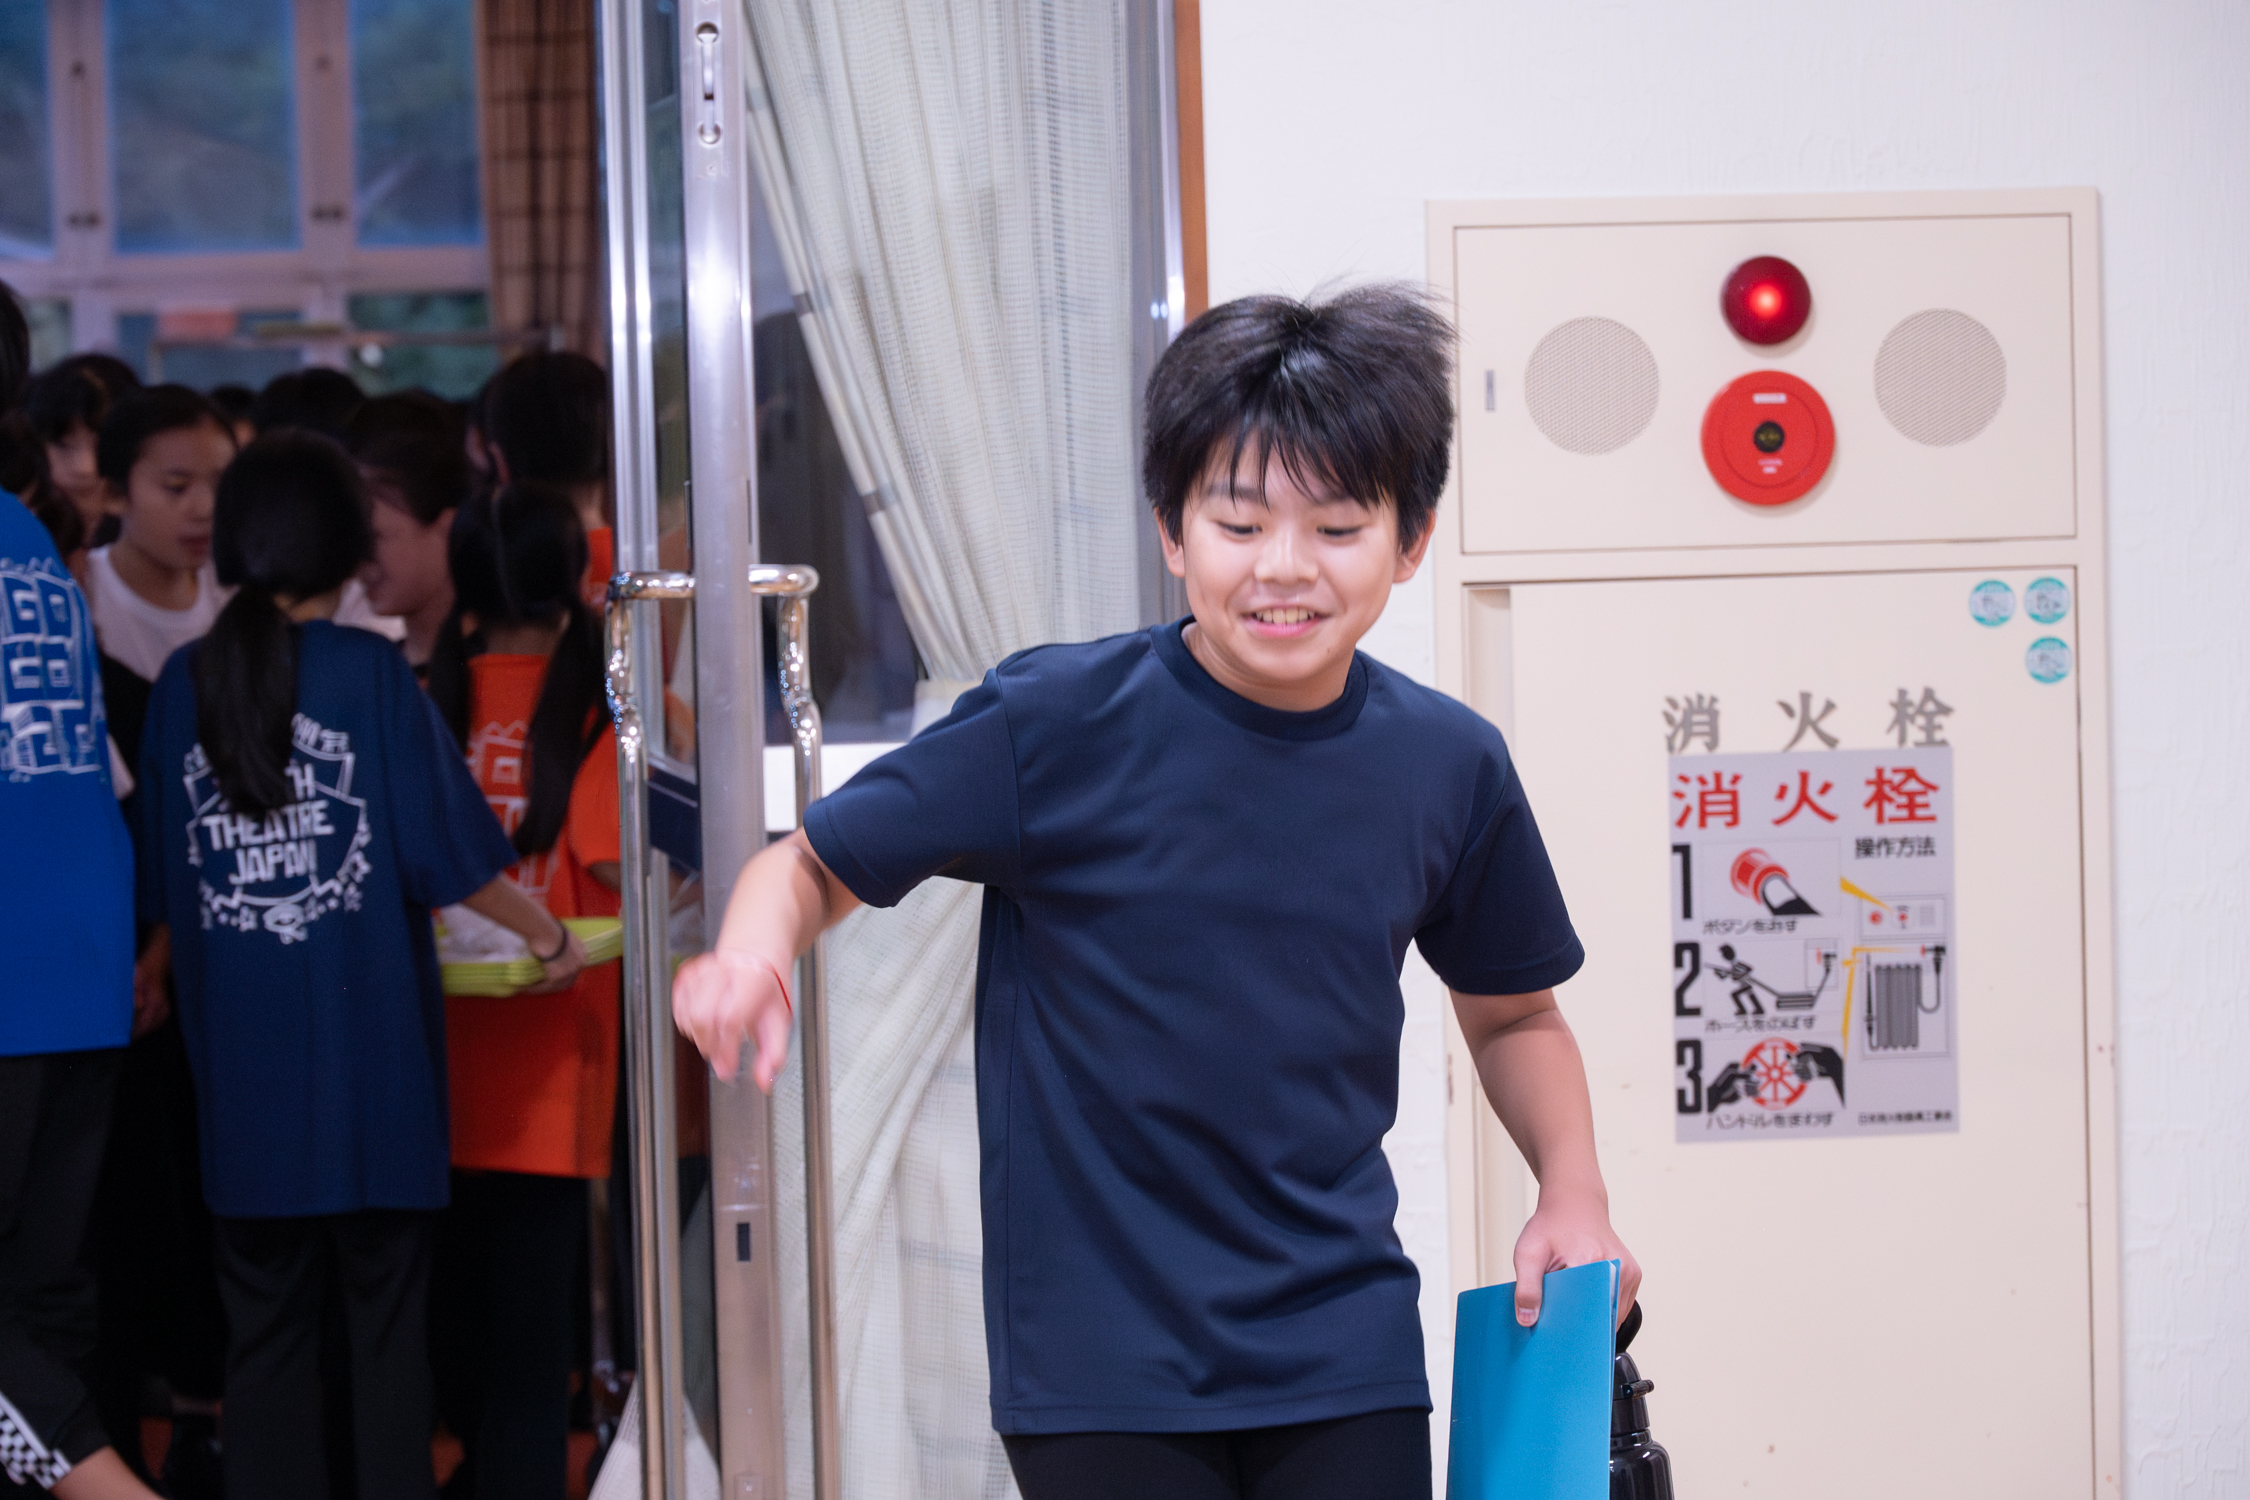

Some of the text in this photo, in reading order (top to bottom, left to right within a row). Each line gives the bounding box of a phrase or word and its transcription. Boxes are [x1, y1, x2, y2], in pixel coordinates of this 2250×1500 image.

[1662, 687, 1954, 753] 消火栓
[201, 799, 335, 850] THEATRE
[1672, 766, 1940, 829] 消火栓
[228, 838, 318, 885] JAPAN
[1854, 836, 1936, 859] 操作方法
[1671, 842, 1692, 920] 1
[1674, 942, 1702, 1017] 2
[1676, 1039, 1703, 1114] 3
